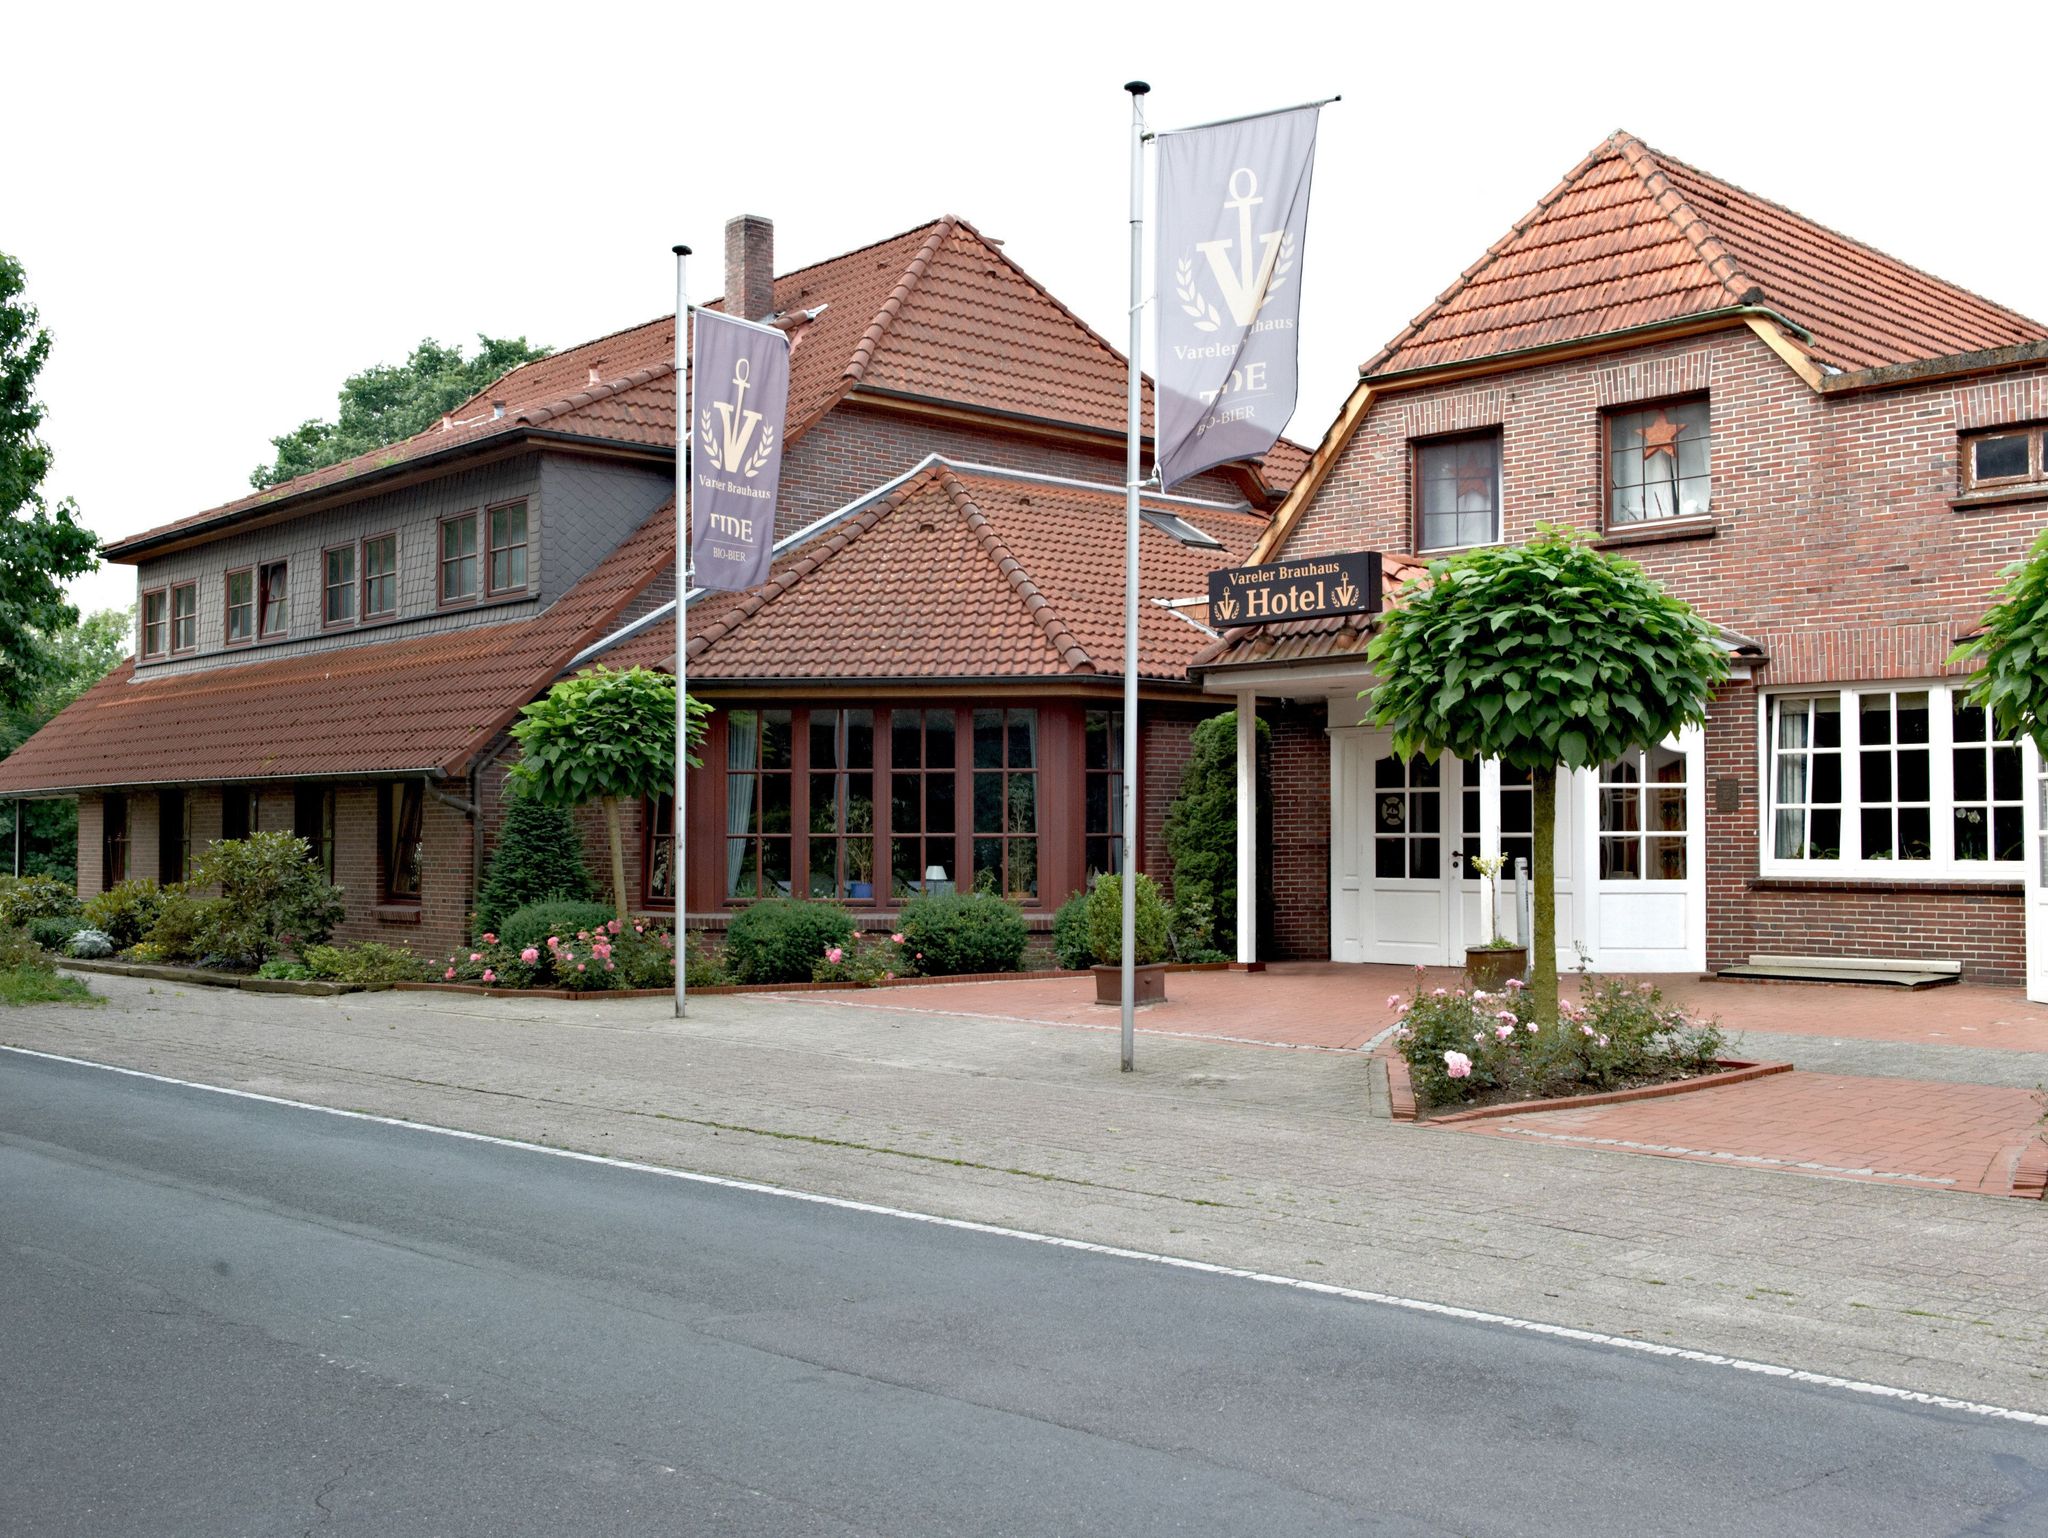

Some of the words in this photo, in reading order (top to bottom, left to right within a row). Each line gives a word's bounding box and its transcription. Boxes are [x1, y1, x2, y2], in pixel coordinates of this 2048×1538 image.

[727, 481, 771, 498] Brauhaus
[713, 546, 746, 562] BIO-BIER
[1229, 570, 1275, 586] Vareler
[1279, 562, 1339, 580] Brauhaus
[1246, 582, 1325, 617] Hotel
